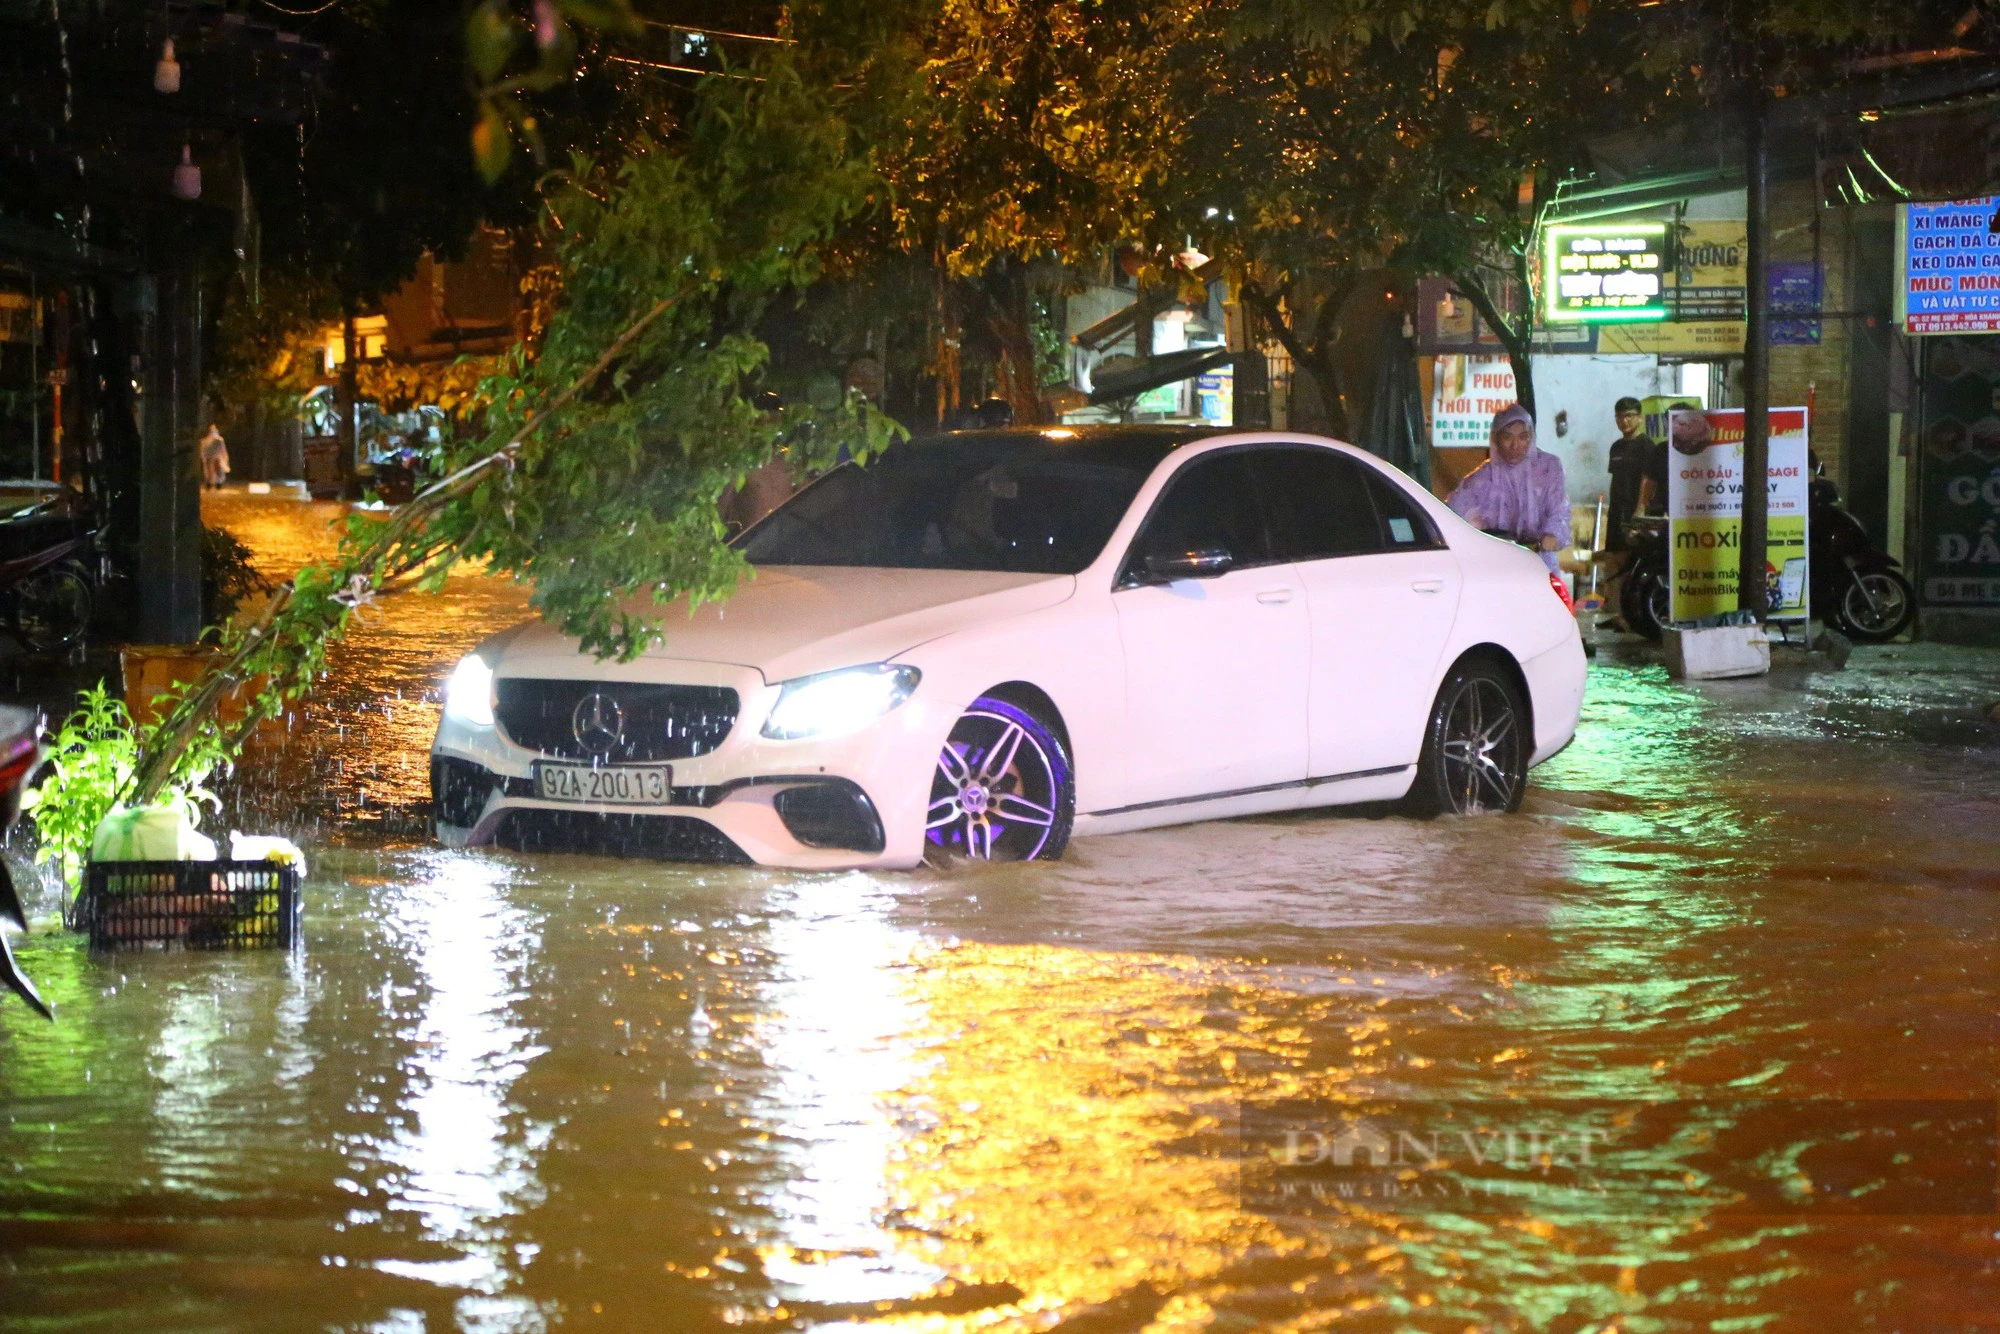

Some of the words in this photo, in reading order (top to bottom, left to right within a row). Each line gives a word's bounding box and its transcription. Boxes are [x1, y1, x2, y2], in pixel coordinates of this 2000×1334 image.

[1915, 216, 1930, 229] XI
[1935, 213, 1982, 229] MĂNG
[1914, 236, 1955, 252] GẠCH
[1912, 256, 1940, 269] KEO
[1922, 295, 1938, 309] VÀ
[1943, 295, 1966, 309] VẬT
[1971, 295, 1988, 307] TƯ
[1702, 570, 1715, 580] xe
